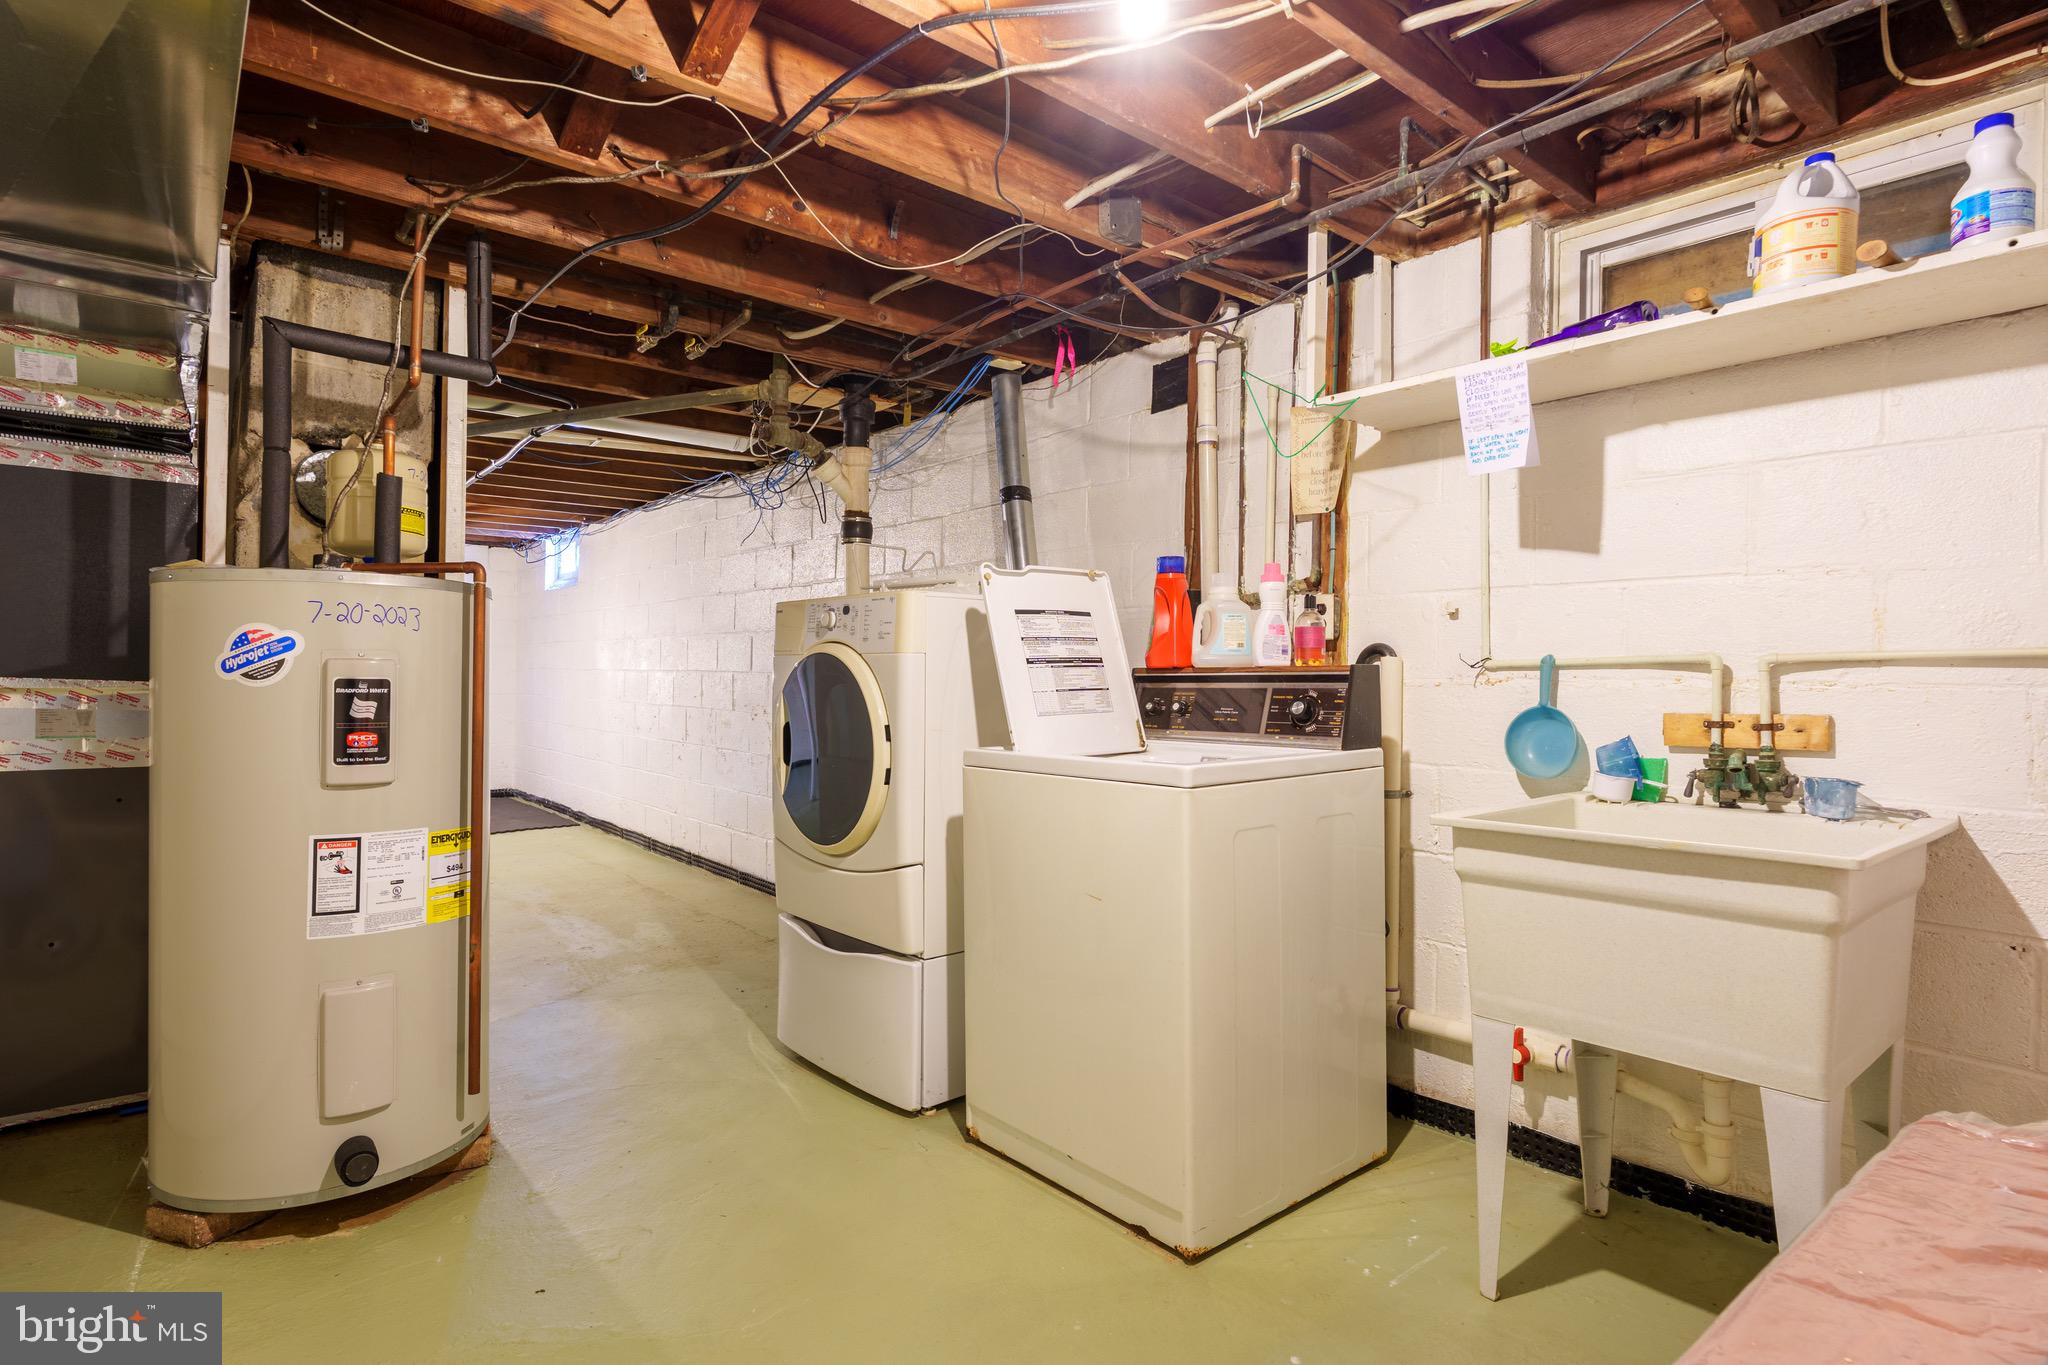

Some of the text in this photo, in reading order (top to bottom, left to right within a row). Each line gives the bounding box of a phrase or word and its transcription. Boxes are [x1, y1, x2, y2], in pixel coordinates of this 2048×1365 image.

[307, 600, 421, 632] 7-20-2023
[225, 645, 270, 670] Hydrojet
[446, 862, 464, 873] $494
